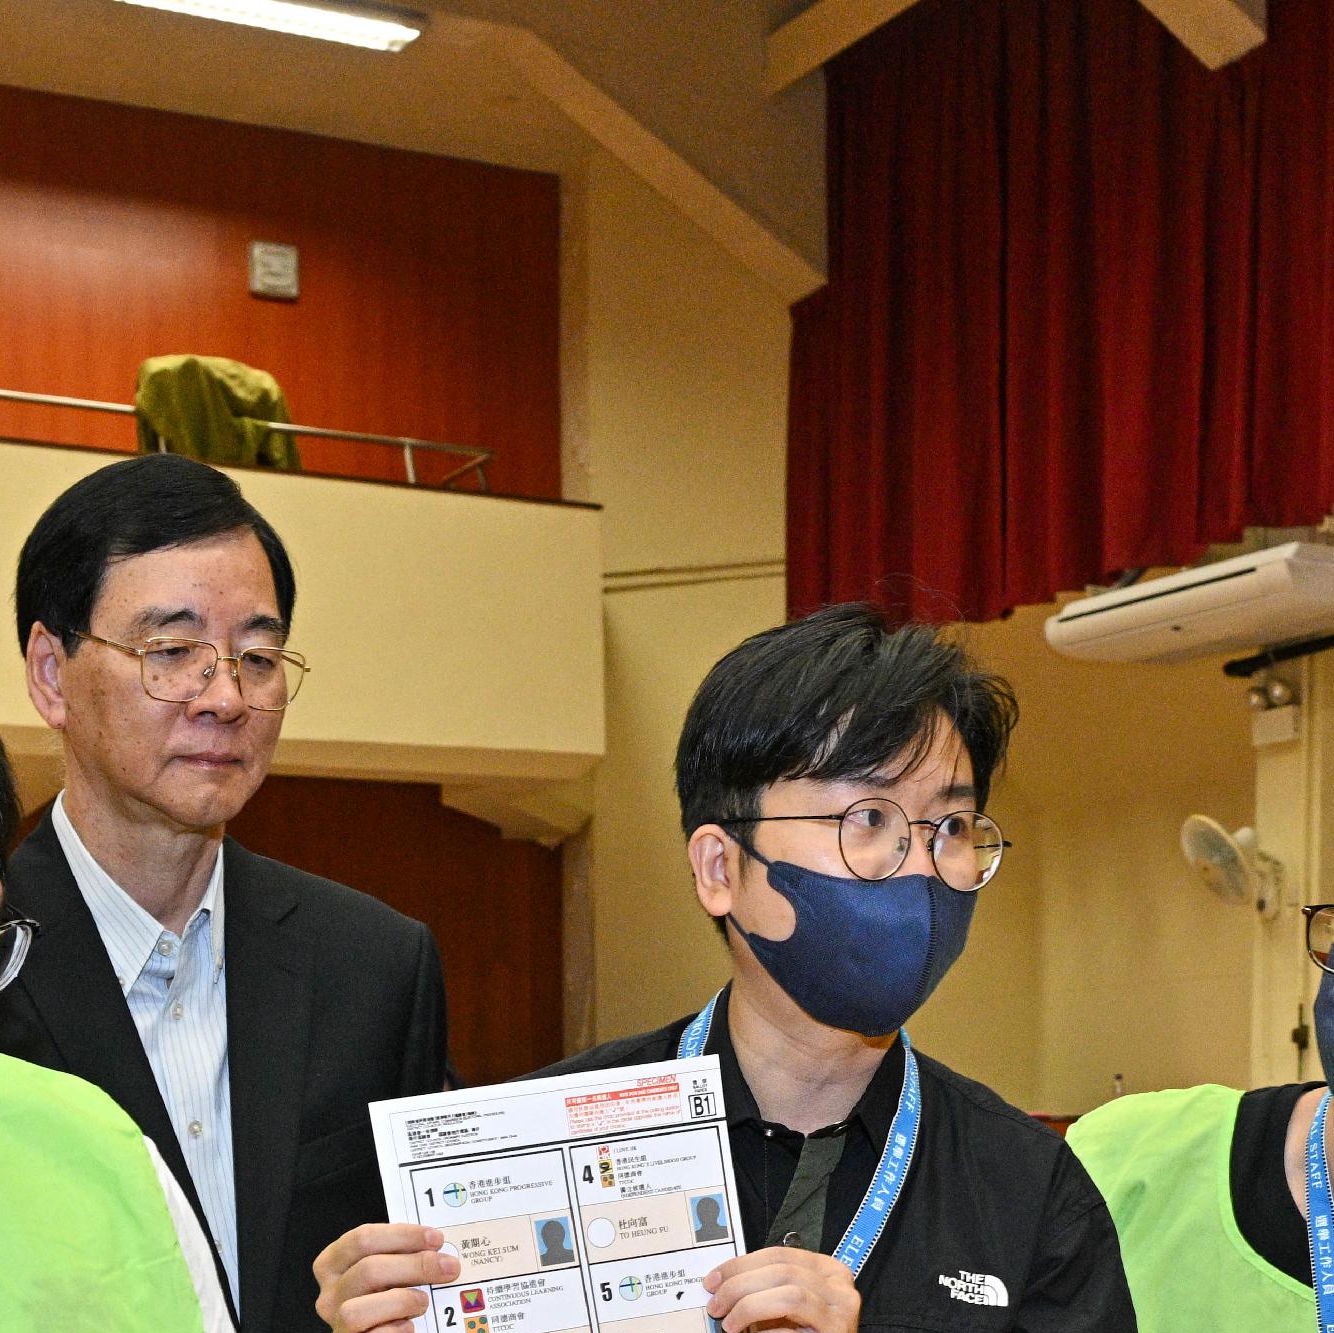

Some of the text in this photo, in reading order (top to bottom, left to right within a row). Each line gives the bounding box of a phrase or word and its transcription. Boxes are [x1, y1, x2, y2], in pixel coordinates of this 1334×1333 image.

[636, 1073, 677, 1087] SPECIMEN
[694, 1096, 711, 1115] B1
[870, 1132, 907, 1212] 選舉工作人員
[1309, 1143, 1322, 1189] STAFF
[582, 1165, 594, 1183] 4
[469, 1176, 510, 1189] 香港進步組
[469, 1180, 553, 1198] HONG KONG PROGRESSIVE
[424, 1187, 435, 1207] 1
[470, 1196, 493, 1204] GROUP
[621, 1189, 650, 1199] INDEPENDENT
[618, 1216, 648, 1230] 杜向富
[620, 1226, 669, 1240] TO HEUNG FU
[462, 1245, 519, 1259] WONG KEI SUM
[1315, 1215, 1334, 1295] 選舉工作人員
[470, 1255, 503, 1266] (NANCY)
[644, 1269, 686, 1284] 香港進步組
[958, 1270, 985, 1285] THE
[599, 1282, 613, 1302] 5
[645, 1283, 664, 1291] HONG
[665, 1280, 683, 1289] KONG
[938, 1274, 984, 1295] NORTH
[487, 1286, 564, 1303] CONTINUOUS LEARNING
[646, 1290, 668, 1298] GROUP
[950, 1288, 985, 1305] FACE
[489, 1298, 531, 1310] ASSOCIATION
[444, 1306, 457, 1327] 2
